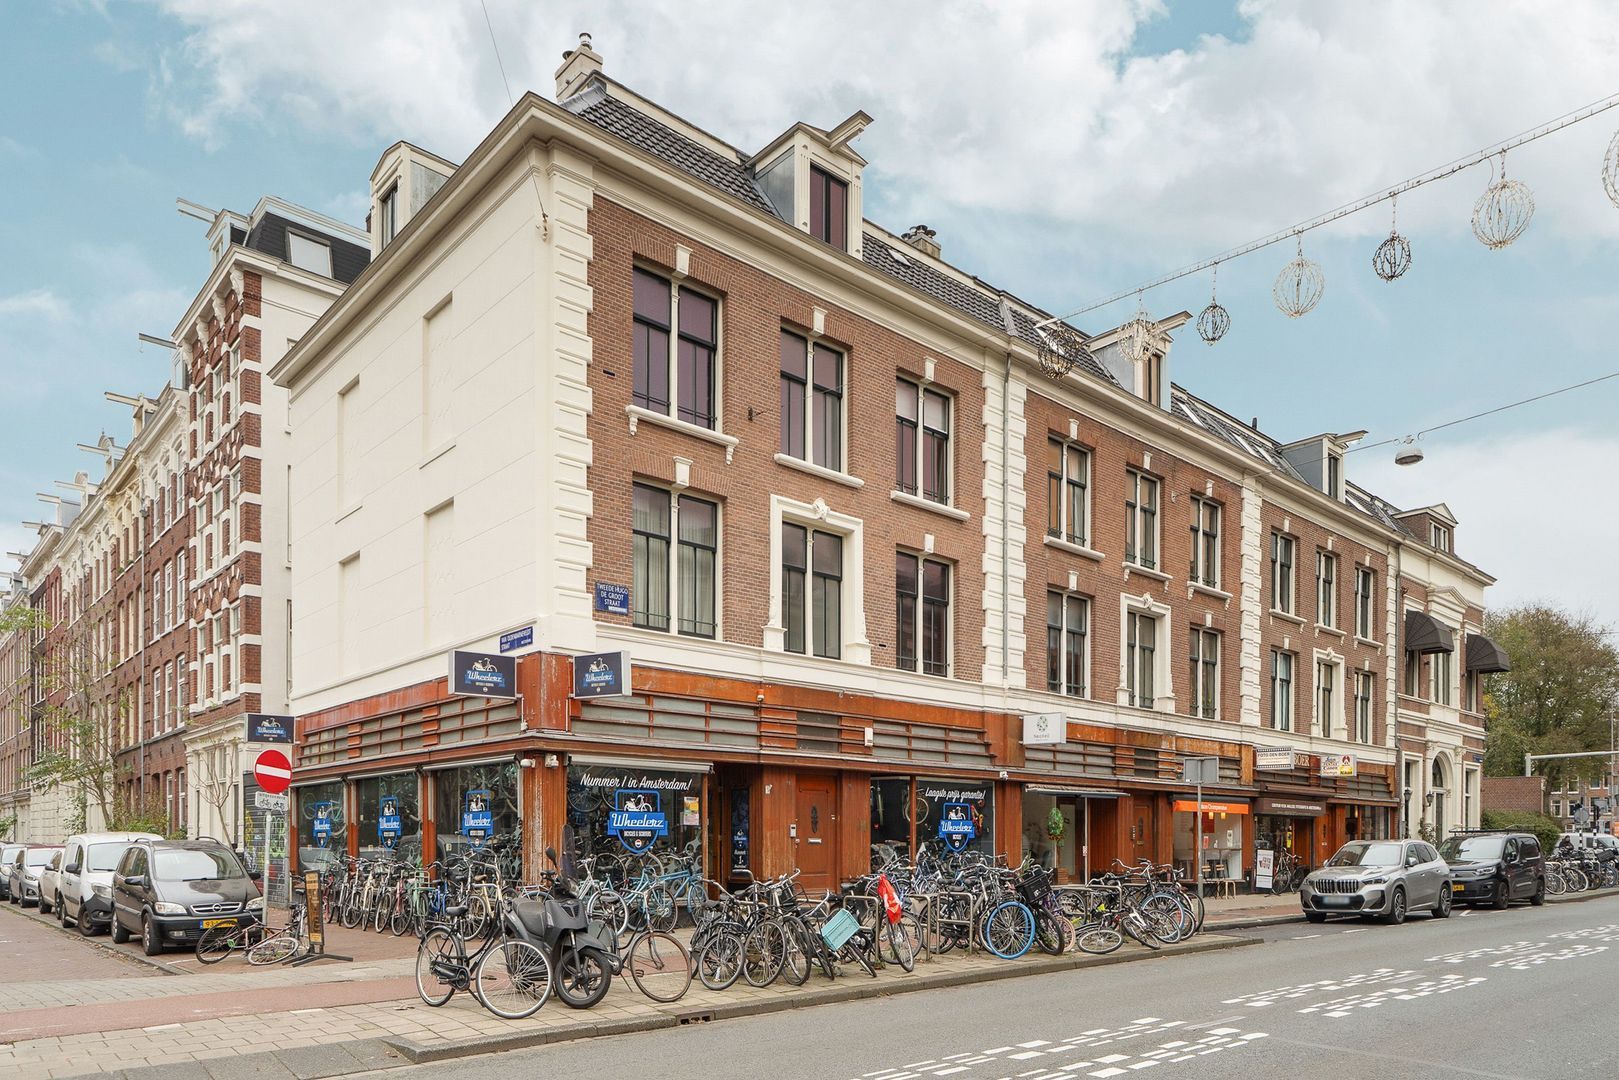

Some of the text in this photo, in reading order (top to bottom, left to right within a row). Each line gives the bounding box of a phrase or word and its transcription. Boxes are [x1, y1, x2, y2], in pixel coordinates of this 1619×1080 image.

[597, 583, 628, 595] TWEEDE HUGO
[604, 598, 620, 606] STRAAT
[608, 592, 624, 600] GROOT
[467, 670, 503, 682] Wheelerz
[585, 672, 612, 682] Wheelerz
[580, 773, 620, 787] Nummer
[628, 777, 637, 788] in
[639, 776, 692, 790] Amsterdam!
[925, 787, 986, 803] Laagste prijs garantie!
[379, 817, 400, 829] Wheelerz
[463, 813, 491, 827] Wheelerz
[611, 812, 664, 828] Wheelerz
[941, 820, 973, 832] Wheelerz
